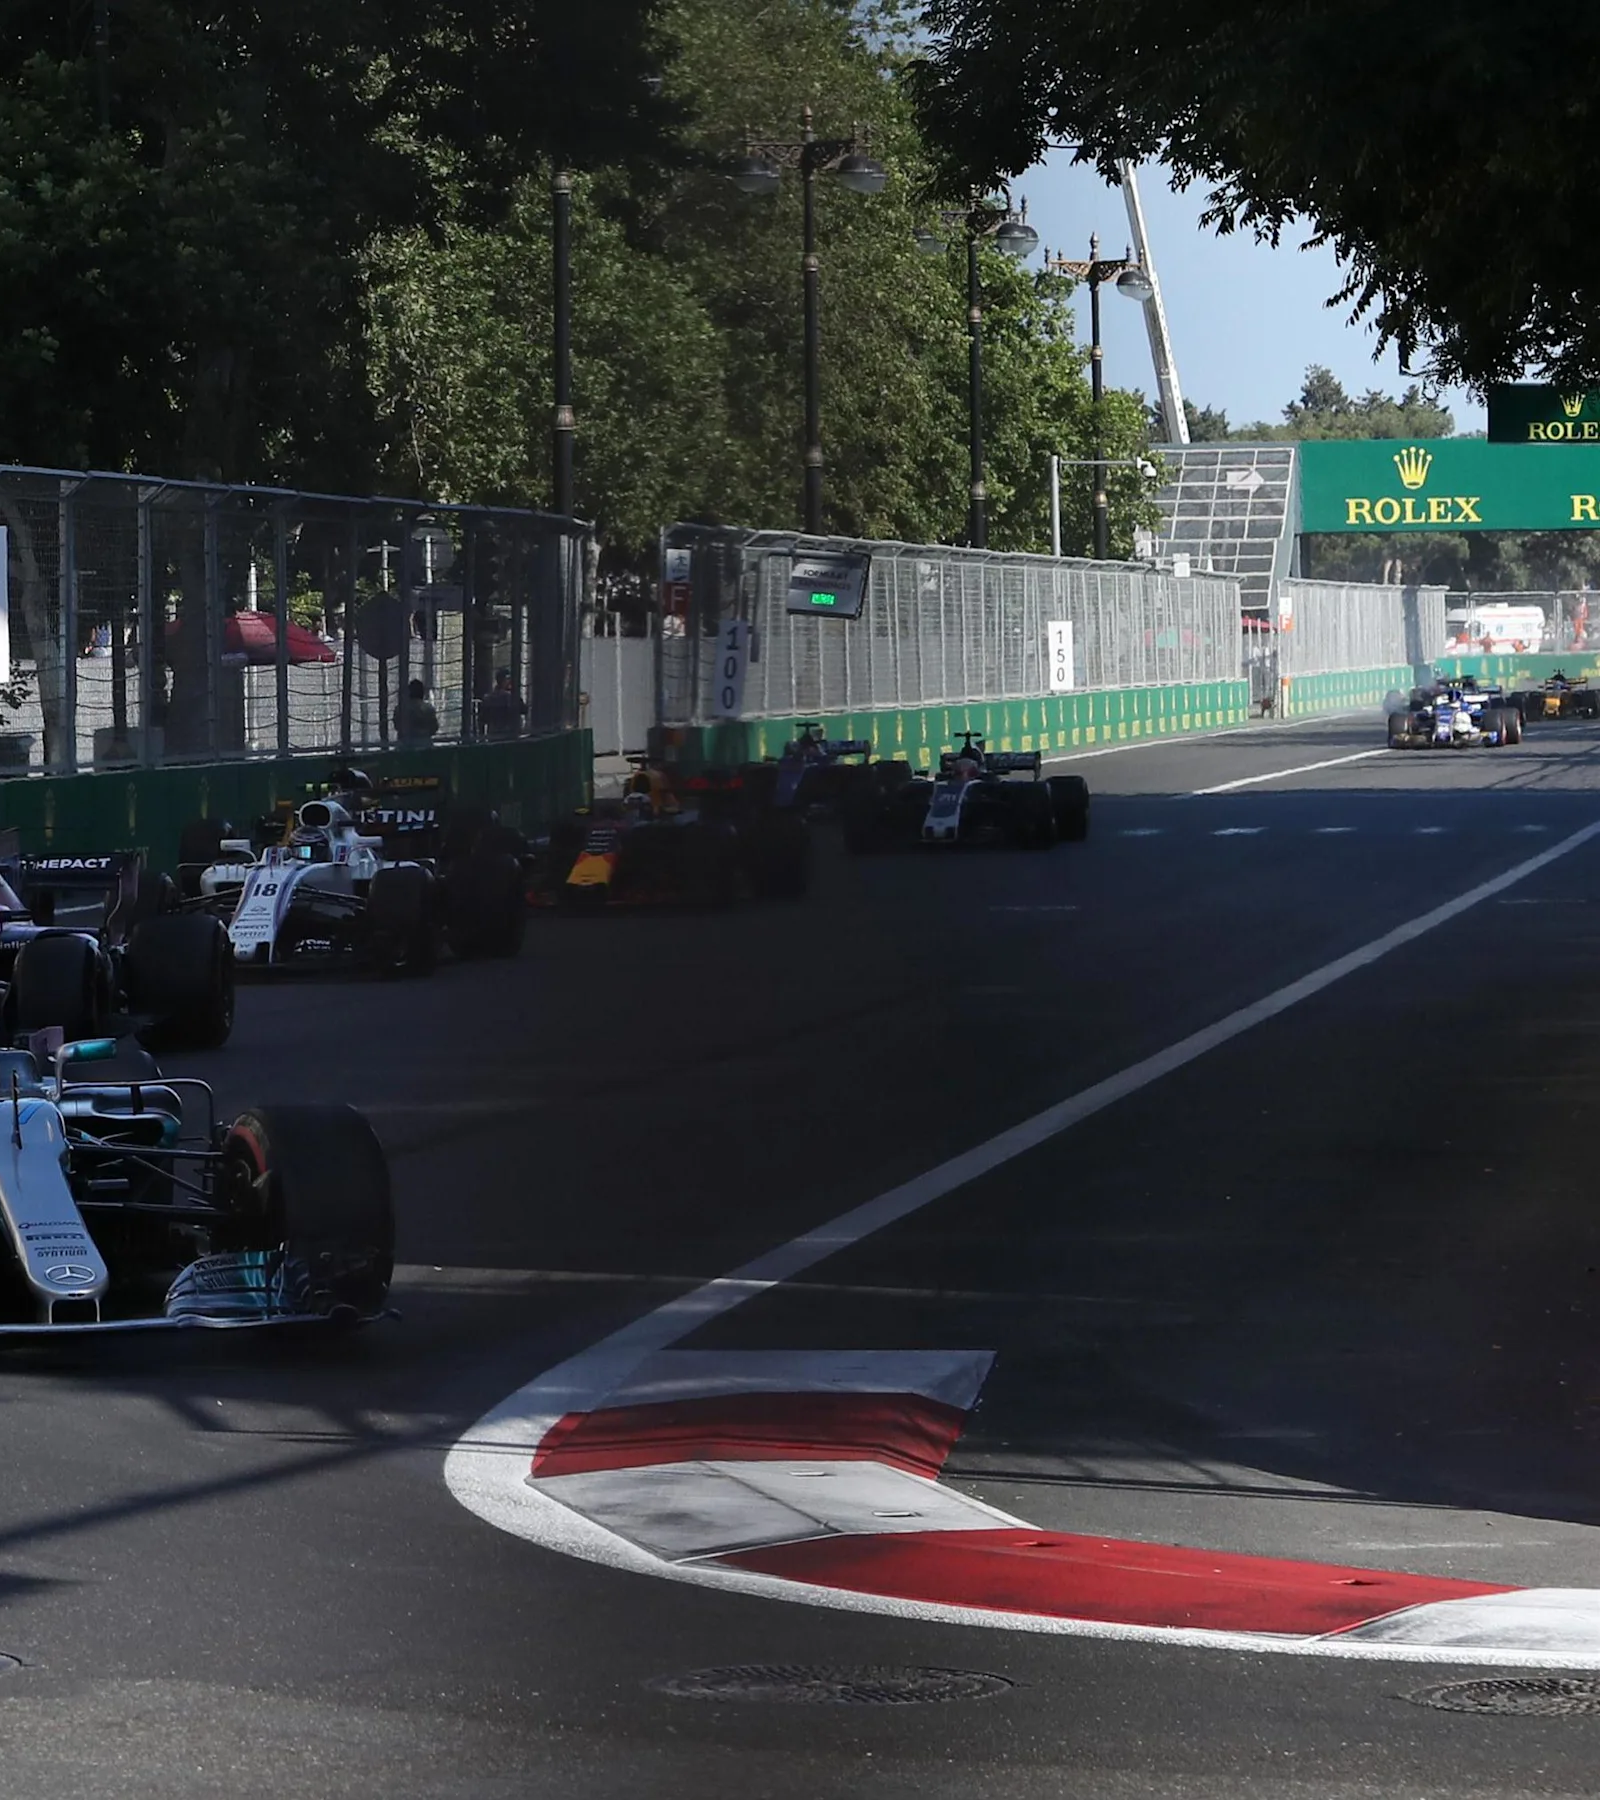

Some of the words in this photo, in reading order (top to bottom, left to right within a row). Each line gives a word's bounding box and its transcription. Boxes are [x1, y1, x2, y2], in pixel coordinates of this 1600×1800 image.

[1527, 421, 1600, 441] ROLE
[1345, 496, 1482, 525] ROLEX
[1056, 629, 1066, 682] 150
[252, 883, 278, 897] 18
